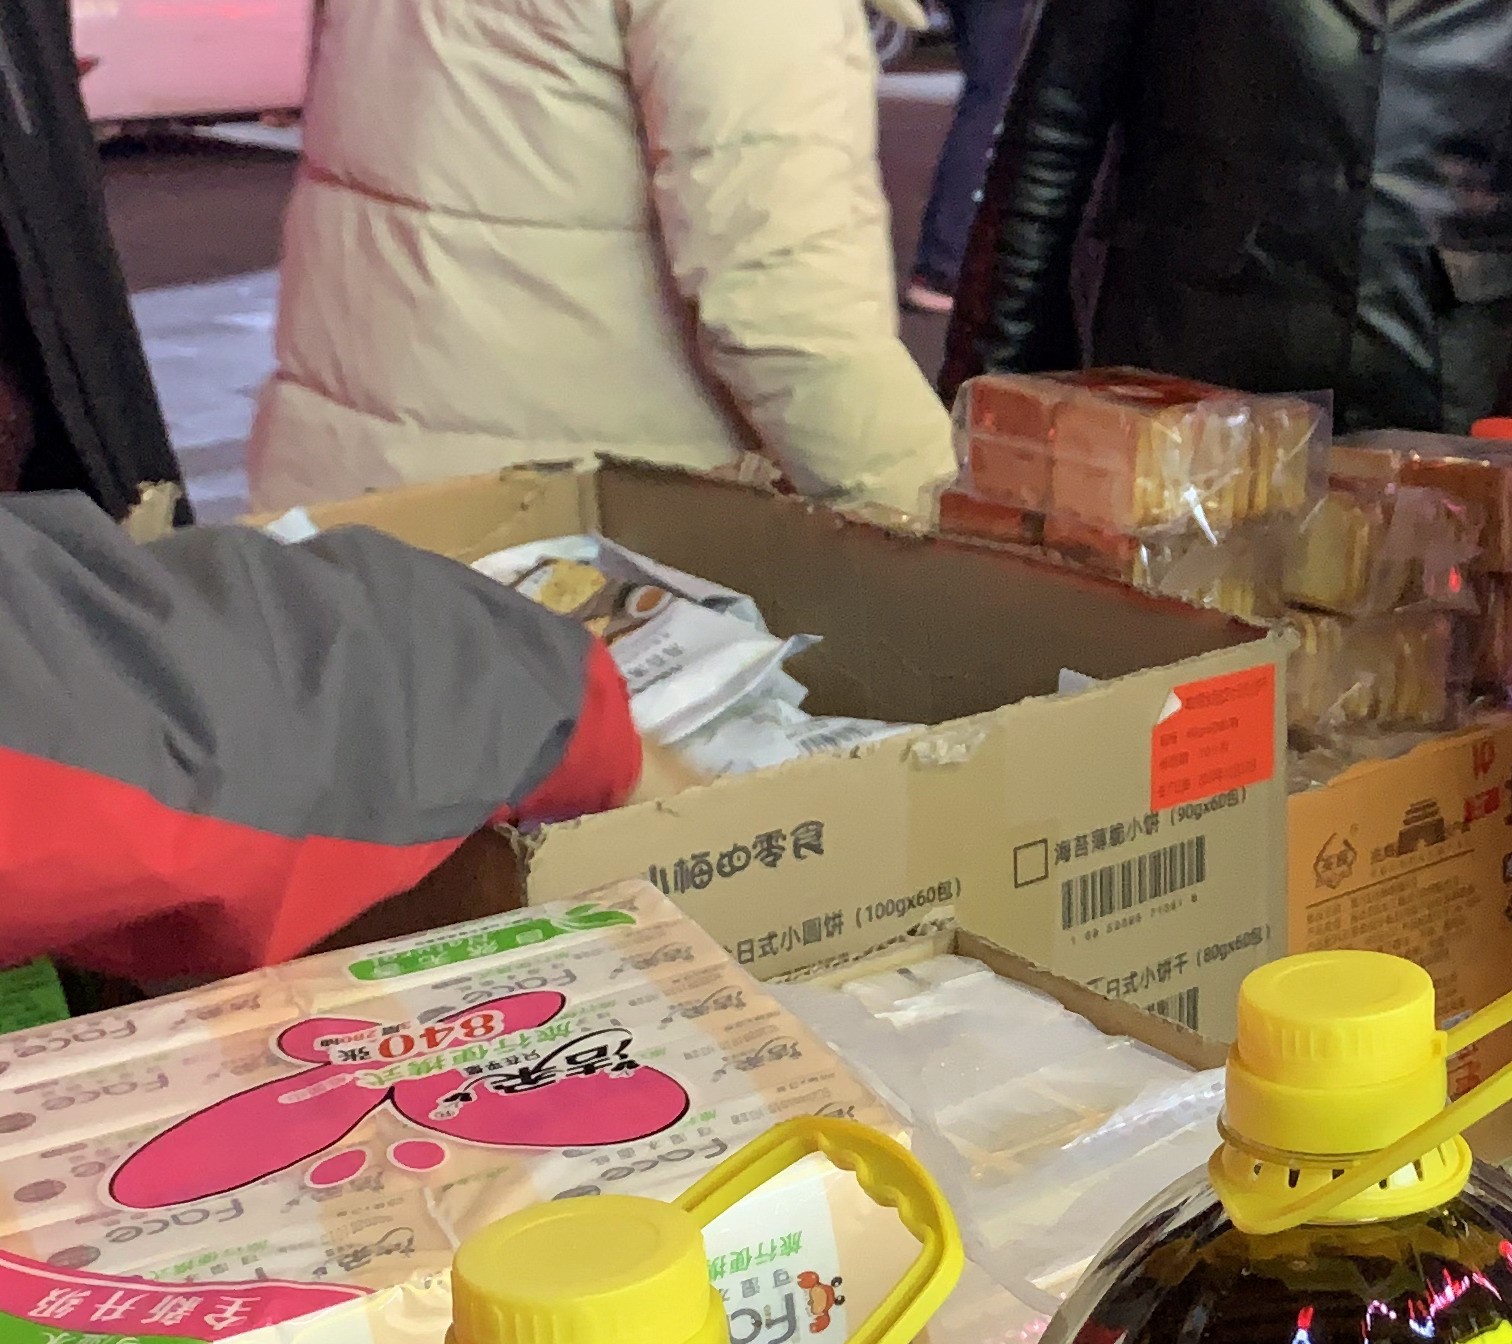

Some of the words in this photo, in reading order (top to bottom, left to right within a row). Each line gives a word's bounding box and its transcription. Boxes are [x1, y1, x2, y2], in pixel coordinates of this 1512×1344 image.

[104, 1198, 245, 1245] Face
[27, 1287, 262, 1332] 全新升级
